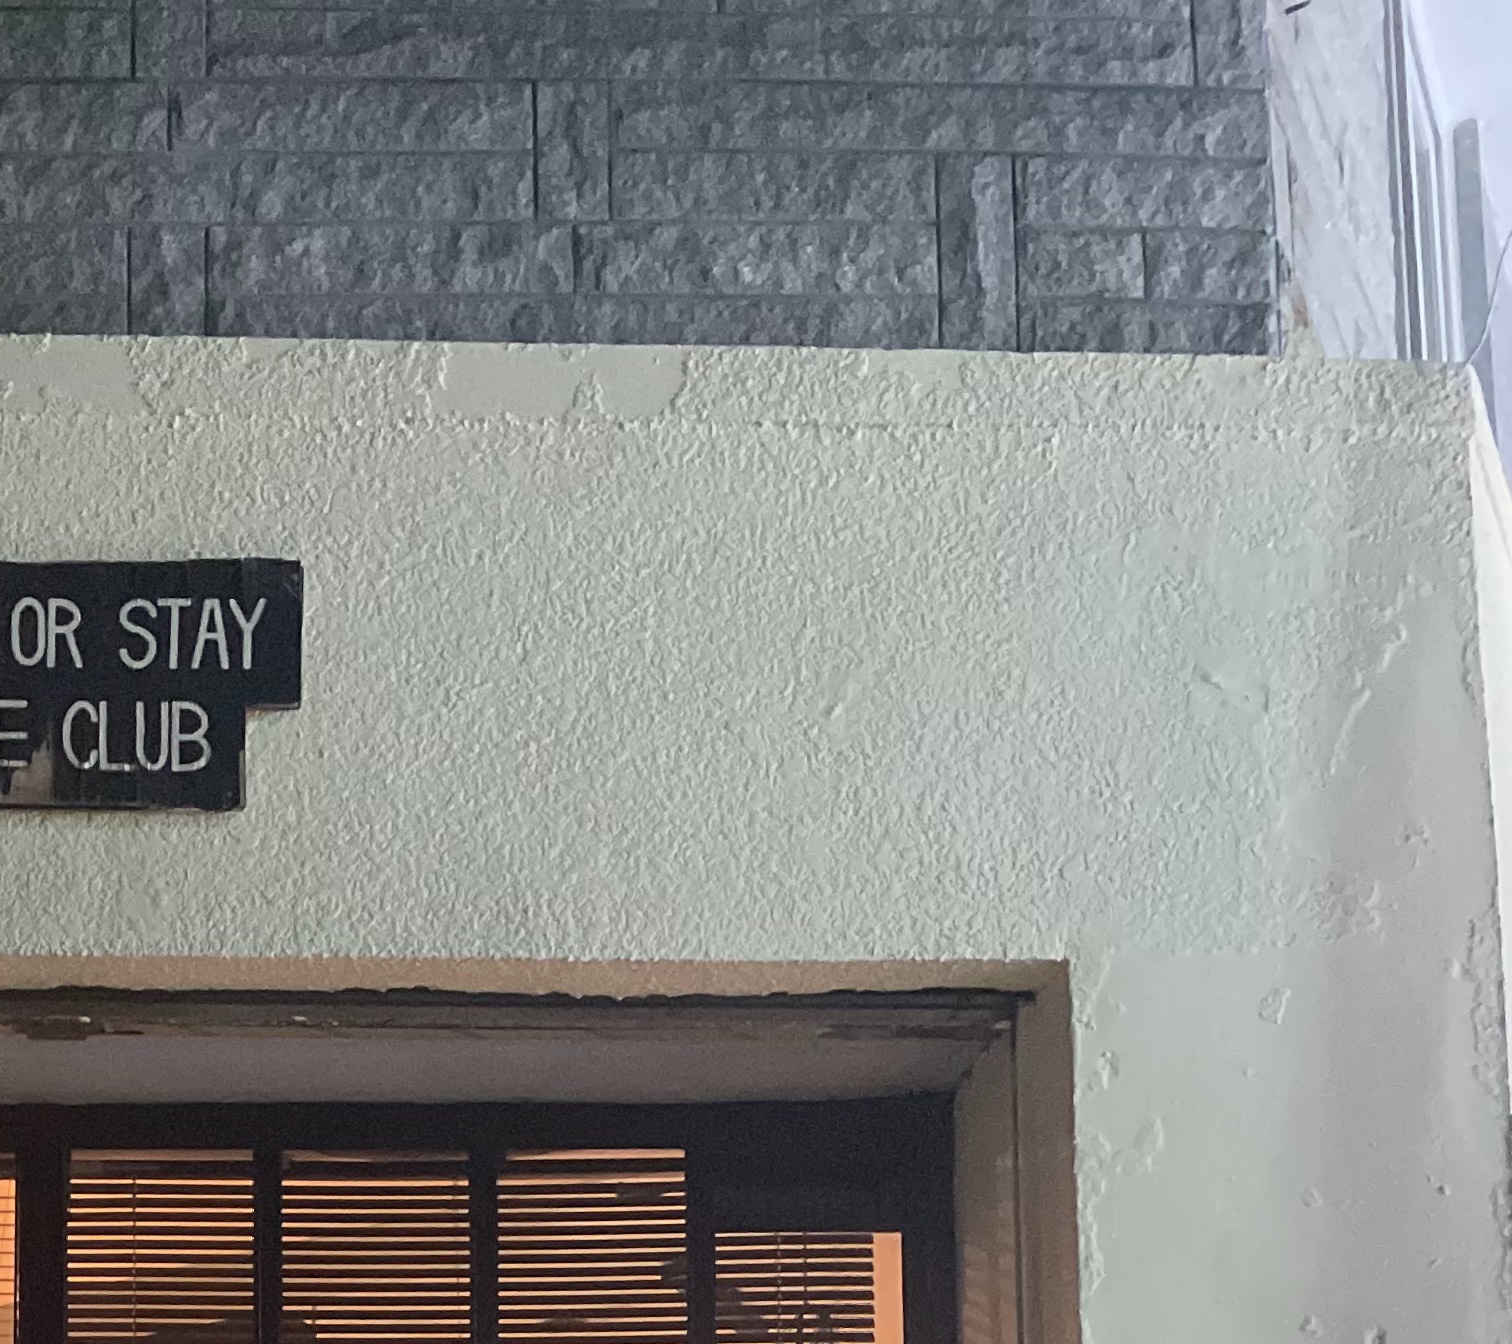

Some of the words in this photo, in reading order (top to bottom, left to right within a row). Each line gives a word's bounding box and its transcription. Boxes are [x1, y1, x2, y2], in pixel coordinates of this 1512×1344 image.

[10, 597, 84, 669] OR
[118, 597, 267, 670] STAY
[62, 700, 212, 773] CLUB
